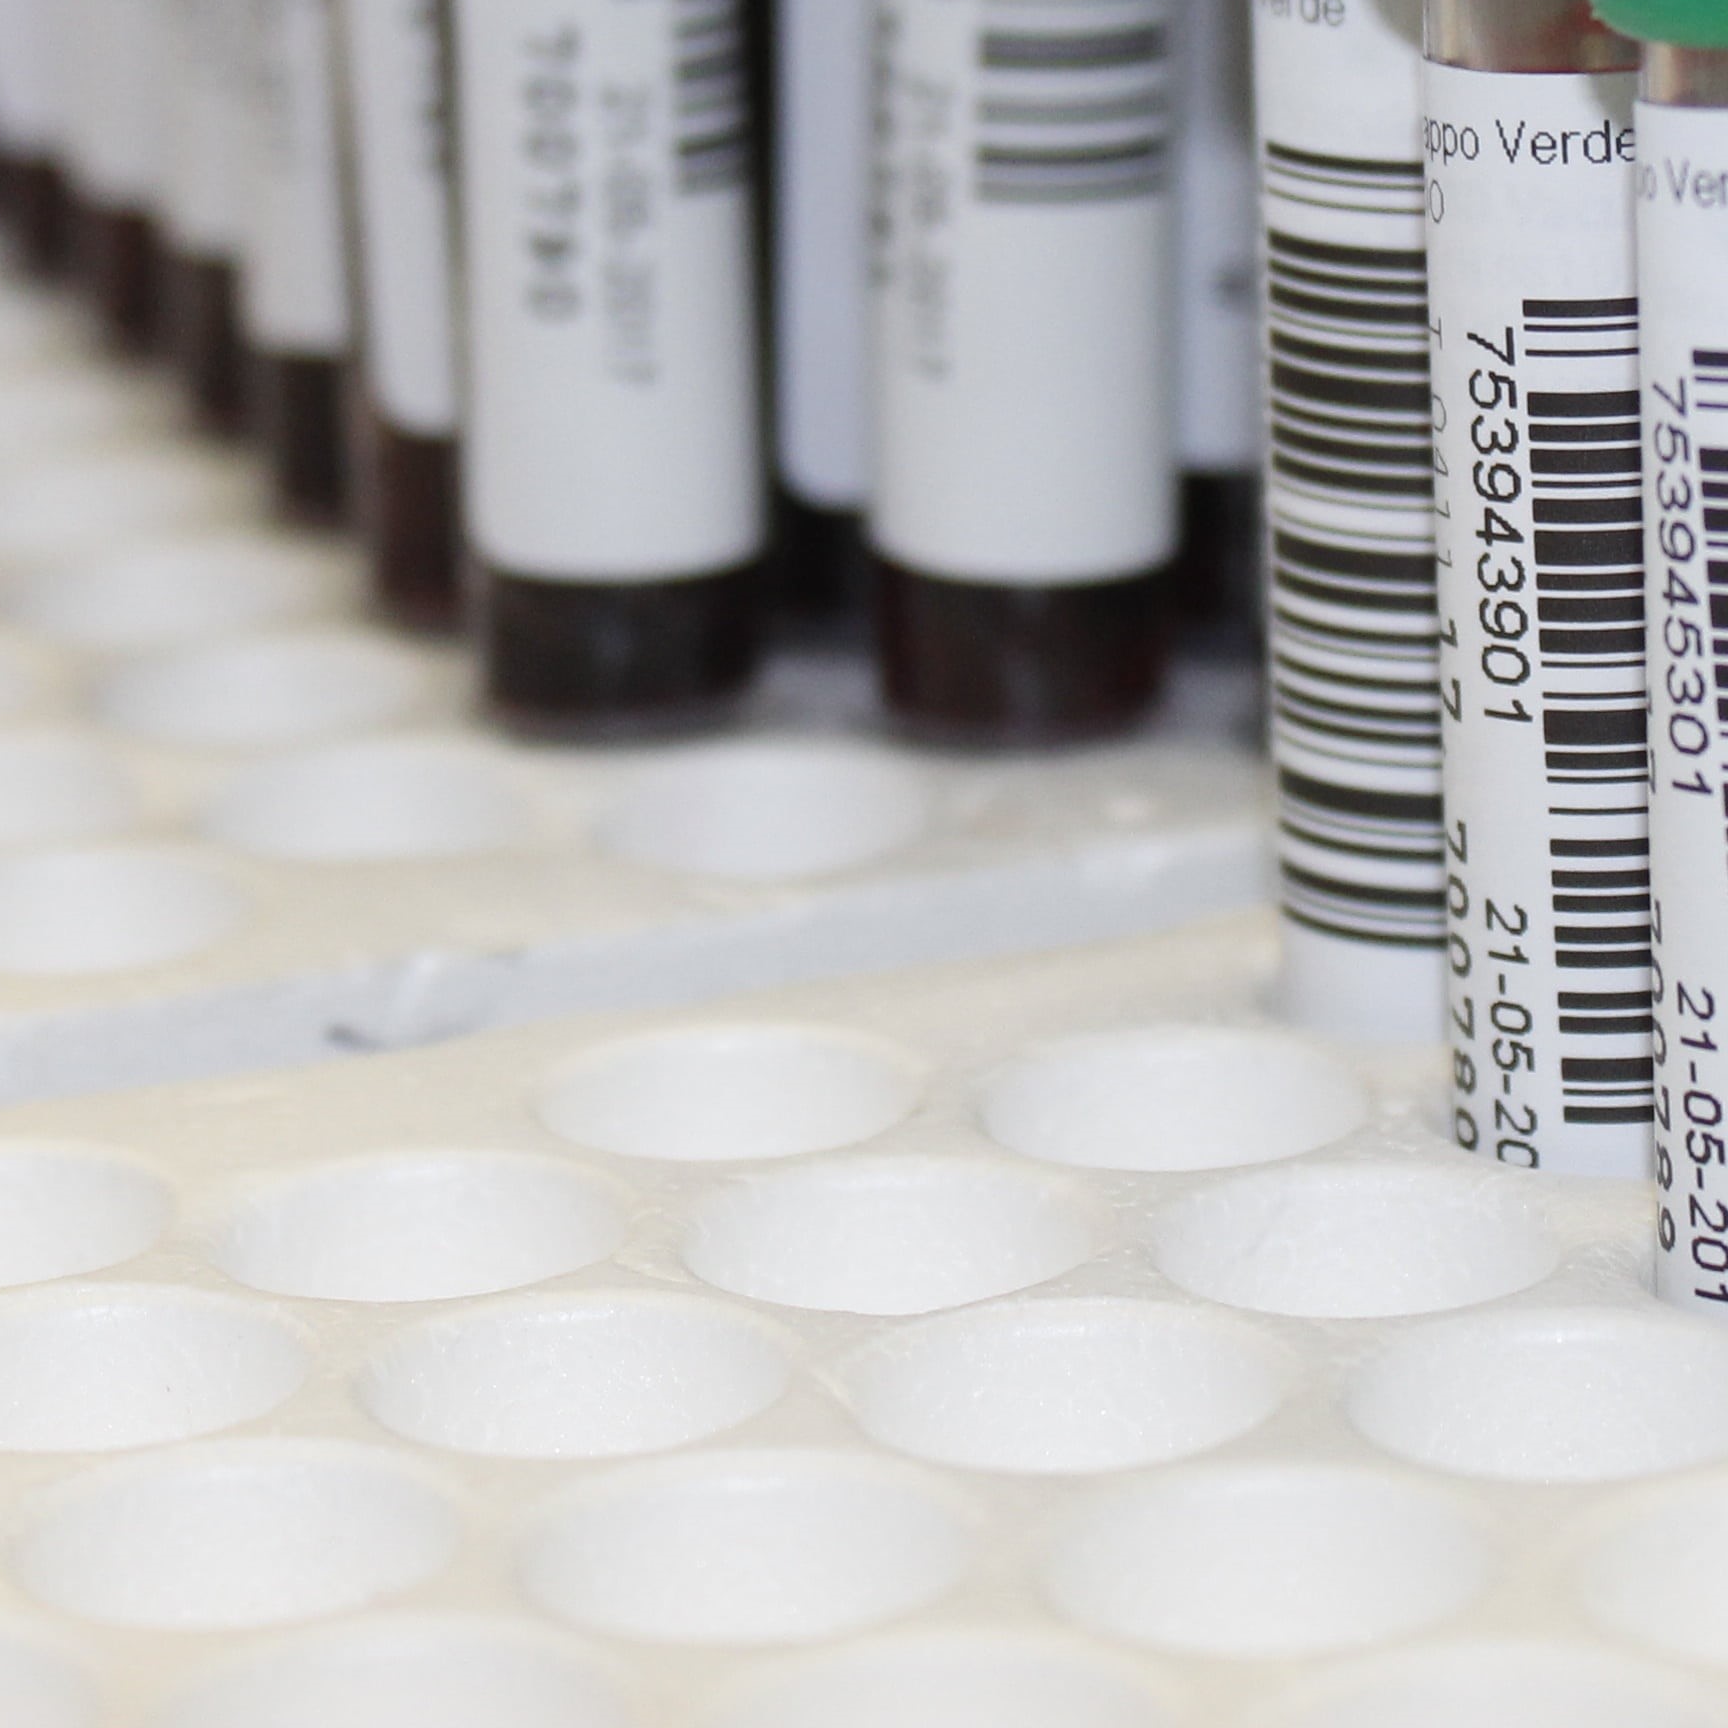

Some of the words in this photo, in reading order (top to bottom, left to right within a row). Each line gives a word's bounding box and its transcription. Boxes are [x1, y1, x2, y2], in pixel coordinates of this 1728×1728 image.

[1495, 119, 1636, 165] Verde
[1467, 326, 1533, 723] 753943901
[1652, 377, 1713, 796] 753945301
